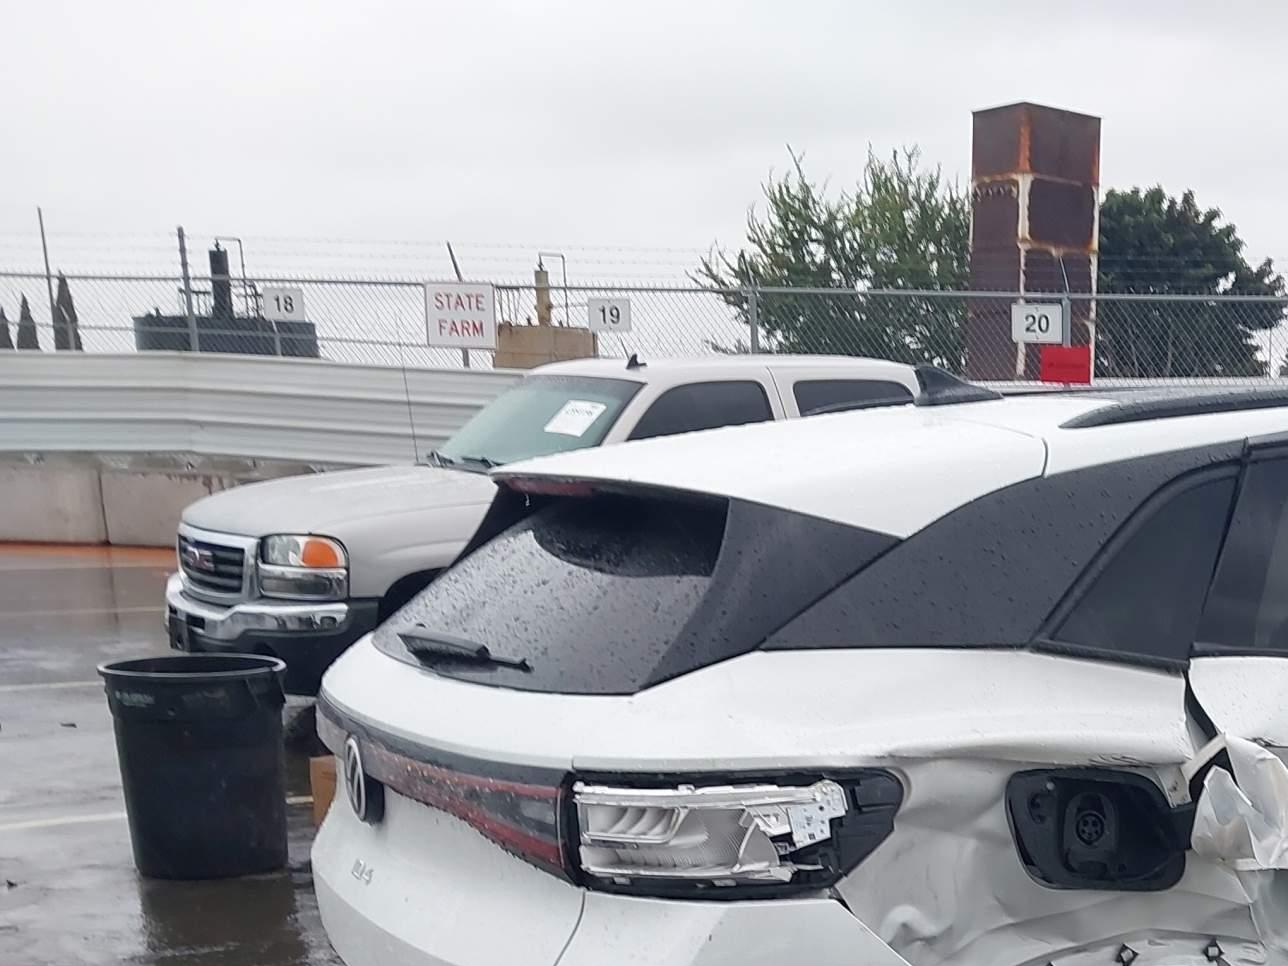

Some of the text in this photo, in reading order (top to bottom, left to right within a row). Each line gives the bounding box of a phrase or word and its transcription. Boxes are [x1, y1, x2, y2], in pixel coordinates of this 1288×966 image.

[273, 295, 295, 313] 18
[434, 293, 486, 312] STATE
[600, 305, 620, 325] 19
[1025, 314, 1050, 334] 20
[438, 320, 484, 337] FARM
